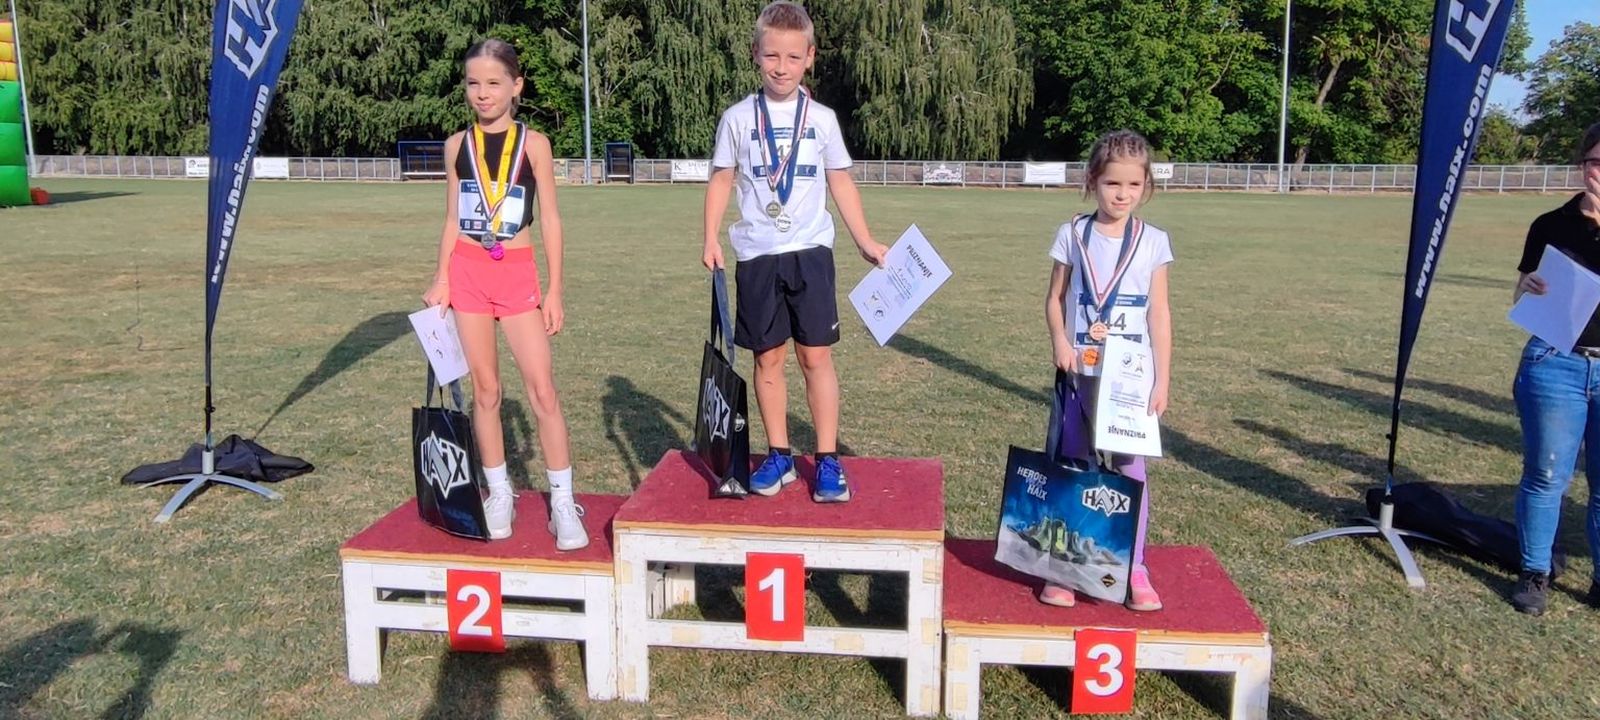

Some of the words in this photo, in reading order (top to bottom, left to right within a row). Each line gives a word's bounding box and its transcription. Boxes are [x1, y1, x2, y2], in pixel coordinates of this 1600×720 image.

[1415, 63, 1493, 299] www.haix.com
[906, 244, 934, 279] PRIZNANJE
[1107, 425, 1147, 440] PRIZNANJE
[1017, 466, 1048, 485] HEROES
[1027, 484, 1048, 501] HAIX
[457, 585, 492, 636] 2
[759, 568, 784, 621] 1
[1084, 643, 1123, 696] 3
